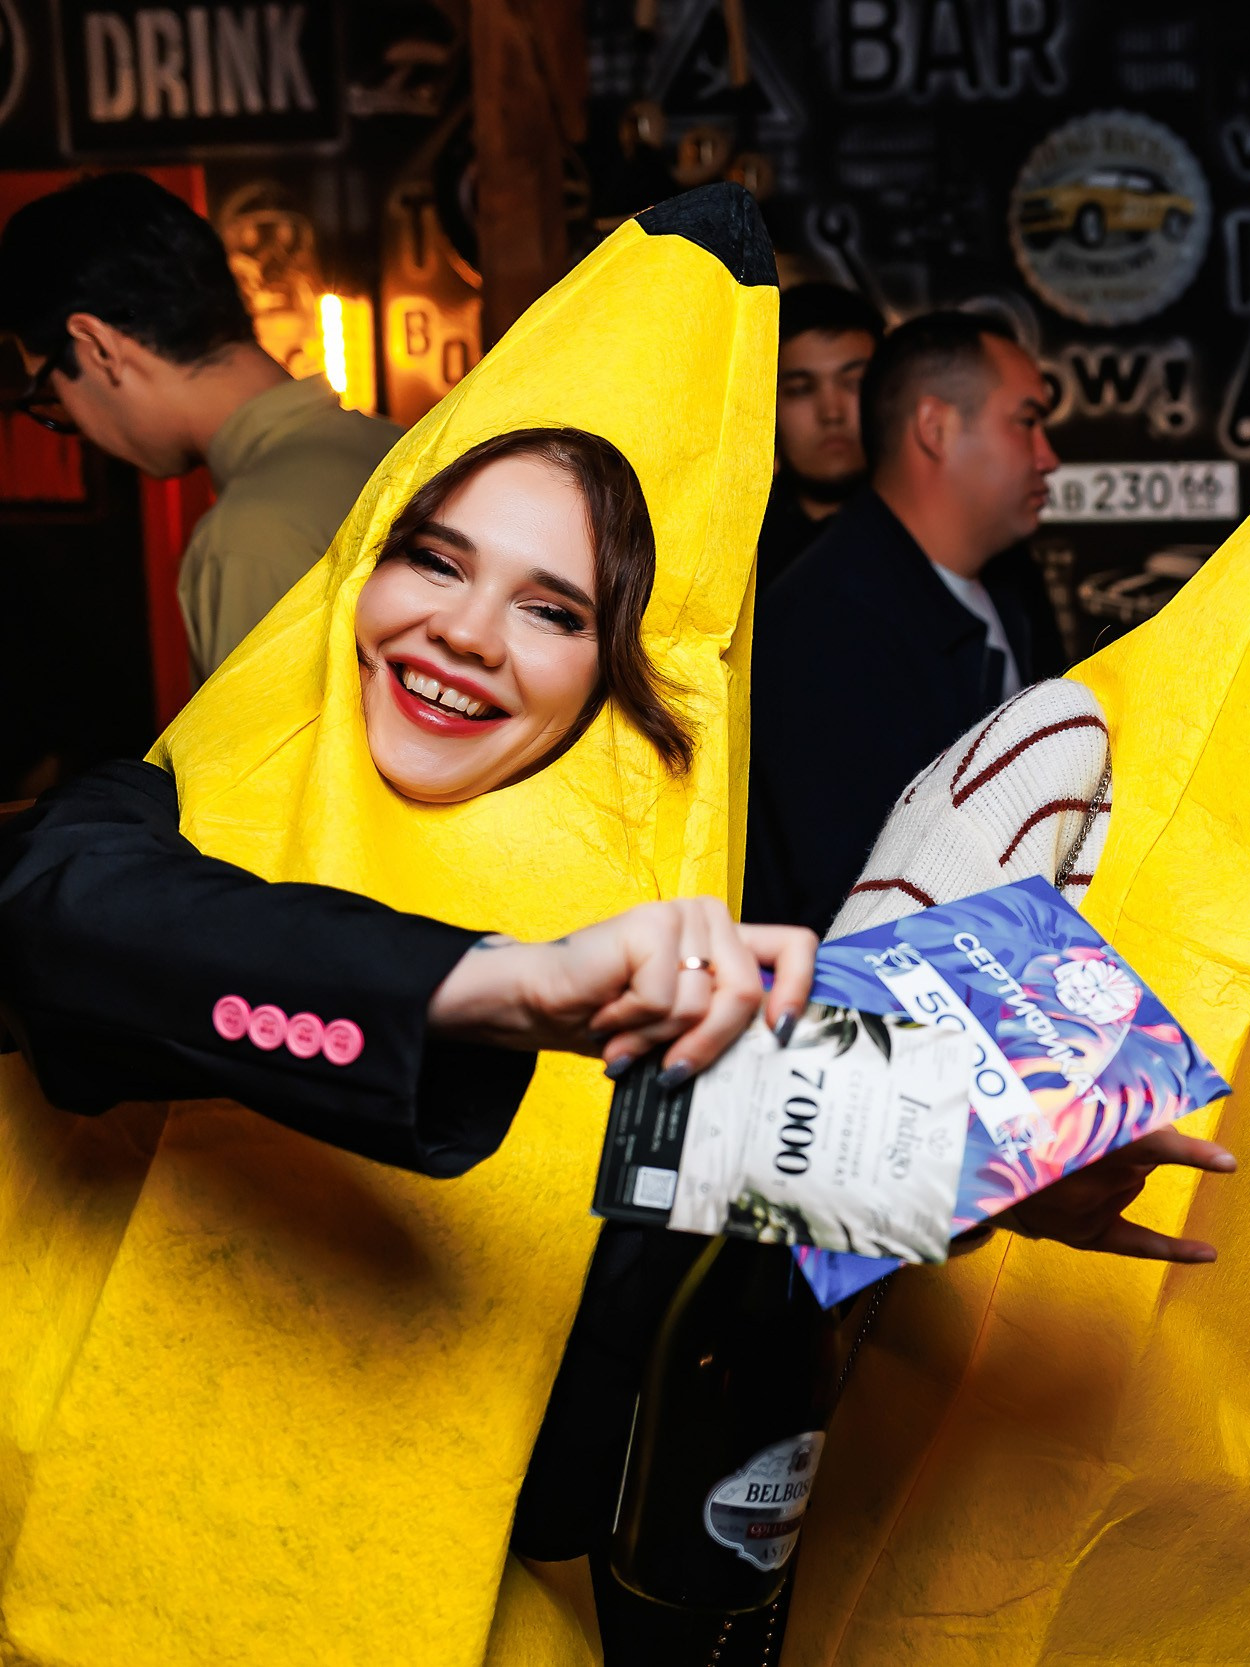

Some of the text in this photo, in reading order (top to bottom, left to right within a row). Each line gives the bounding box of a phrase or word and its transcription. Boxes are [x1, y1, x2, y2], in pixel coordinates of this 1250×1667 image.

[84, 4, 316, 123] DRINK
[839, 0, 1058, 93] BAR
[952, 931, 1109, 1108] СЕРТИФИКАТ
[885, 1094, 932, 1180] Indigo
